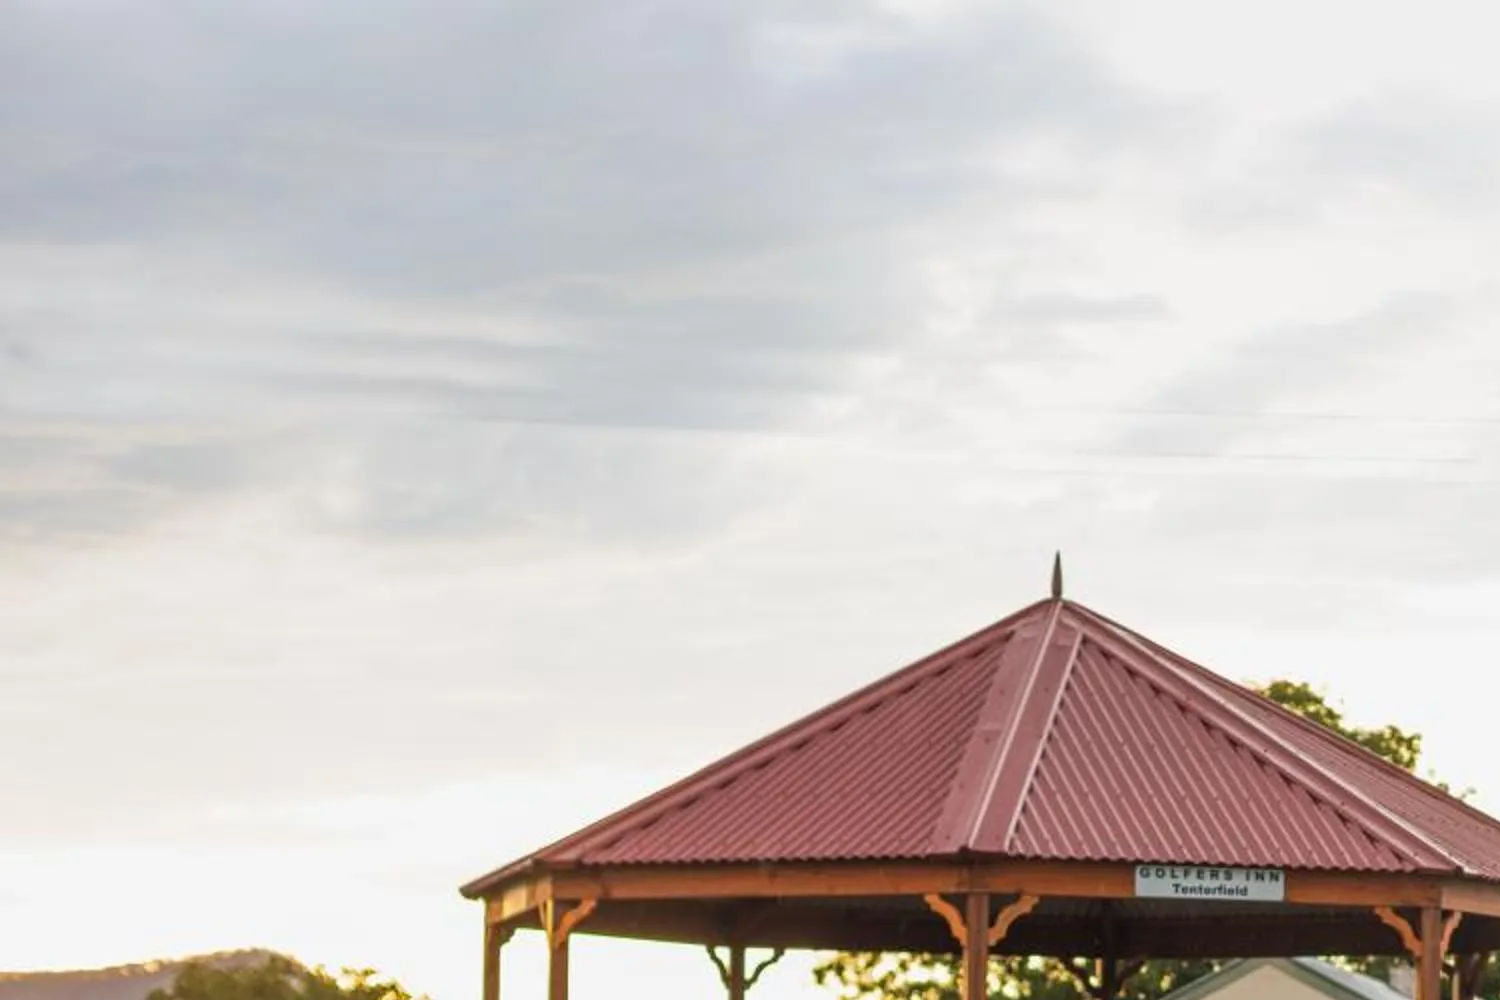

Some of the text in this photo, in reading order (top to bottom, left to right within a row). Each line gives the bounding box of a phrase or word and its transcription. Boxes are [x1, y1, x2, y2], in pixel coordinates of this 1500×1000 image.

[1139, 866, 1280, 882] GOLFERS INN
[1172, 883, 1249, 897] Tenterfield
